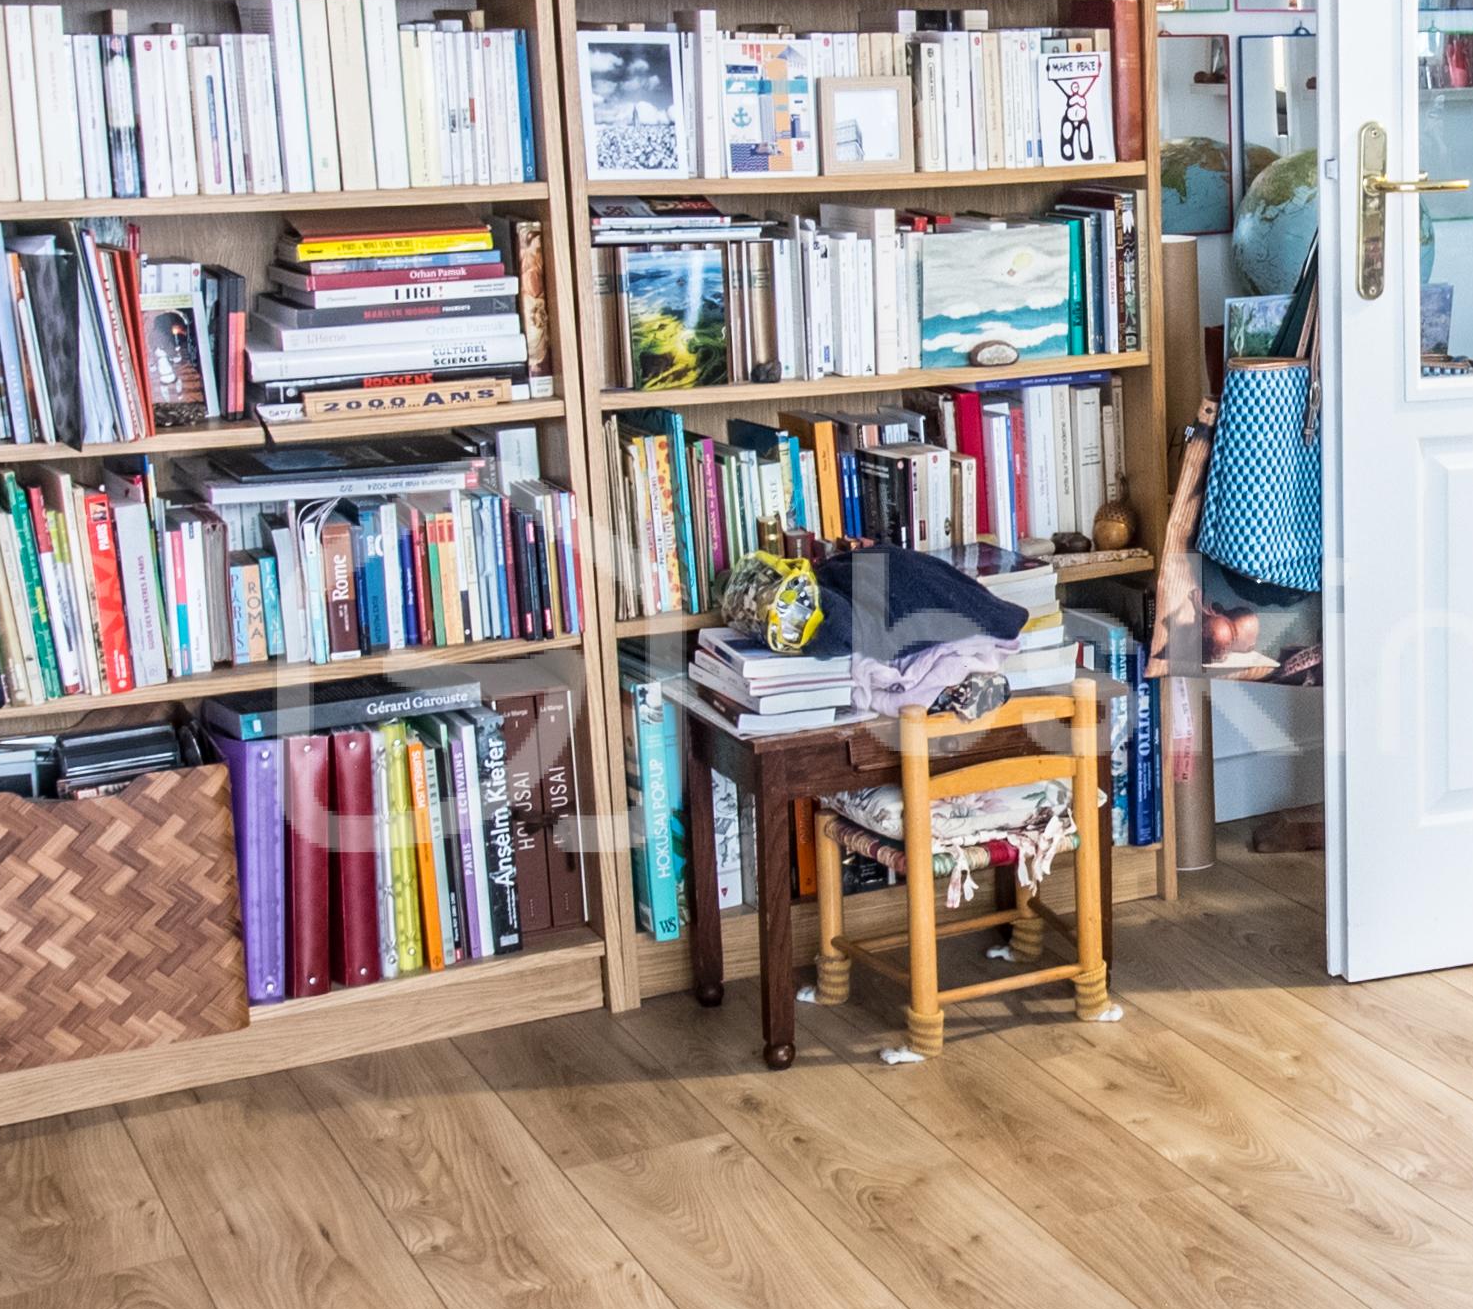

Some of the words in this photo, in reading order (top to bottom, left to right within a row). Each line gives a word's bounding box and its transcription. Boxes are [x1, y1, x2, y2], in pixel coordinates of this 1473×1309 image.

[1052, 62, 1073, 72] MAKE
[1077, 61, 1096, 71] PEACE
[410, 269, 436, 279] Orhan
[437, 267, 467, 278] Pamuk
[432, 345, 488, 356] CULTUREL
[434, 355, 488, 366] SCIENCES
[324, 397, 407, 412] 2000
[422, 389, 495, 407] ANS
[96, 523, 110, 551] PARIS
[137, 556, 146, 574] PARIS
[331, 554, 349, 601] Rome
[141, 582, 152, 614] PEINTRES
[231, 574, 247, 649] PARIS
[247, 581, 263, 640] ROMA
[144, 615, 154, 628] DES
[145, 629, 156, 650] GUIDE
[366, 698, 411, 716] Gérard
[413, 692, 469, 710] Garouste
[411, 751, 426, 810] SURREALISM
[486, 738, 508, 803] Kiefer
[649, 759, 666, 809] POP-UP
[464, 842, 474, 876] PARIS
[491, 808, 515, 886] Anselm
[653, 812, 671, 879] HOKUSAI
